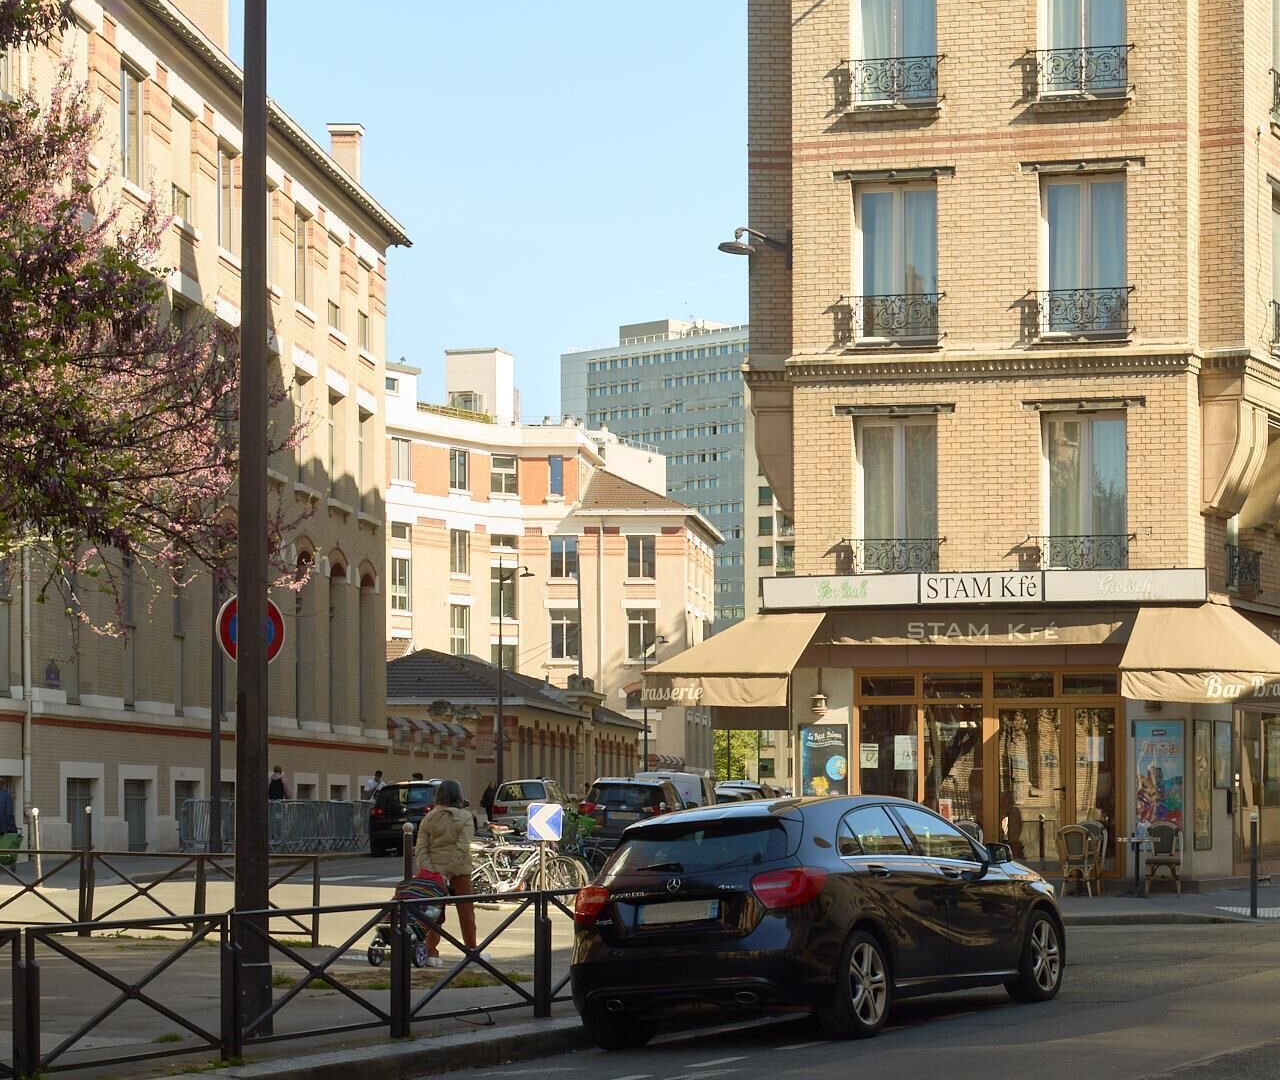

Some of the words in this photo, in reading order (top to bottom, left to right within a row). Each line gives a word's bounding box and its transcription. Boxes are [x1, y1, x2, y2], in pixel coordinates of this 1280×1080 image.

[926, 576, 993, 600] STAM
[1000, 575, 1037, 598] Kfé
[907, 622, 989, 640] STAM
[1204, 674, 1245, 699] Bar
